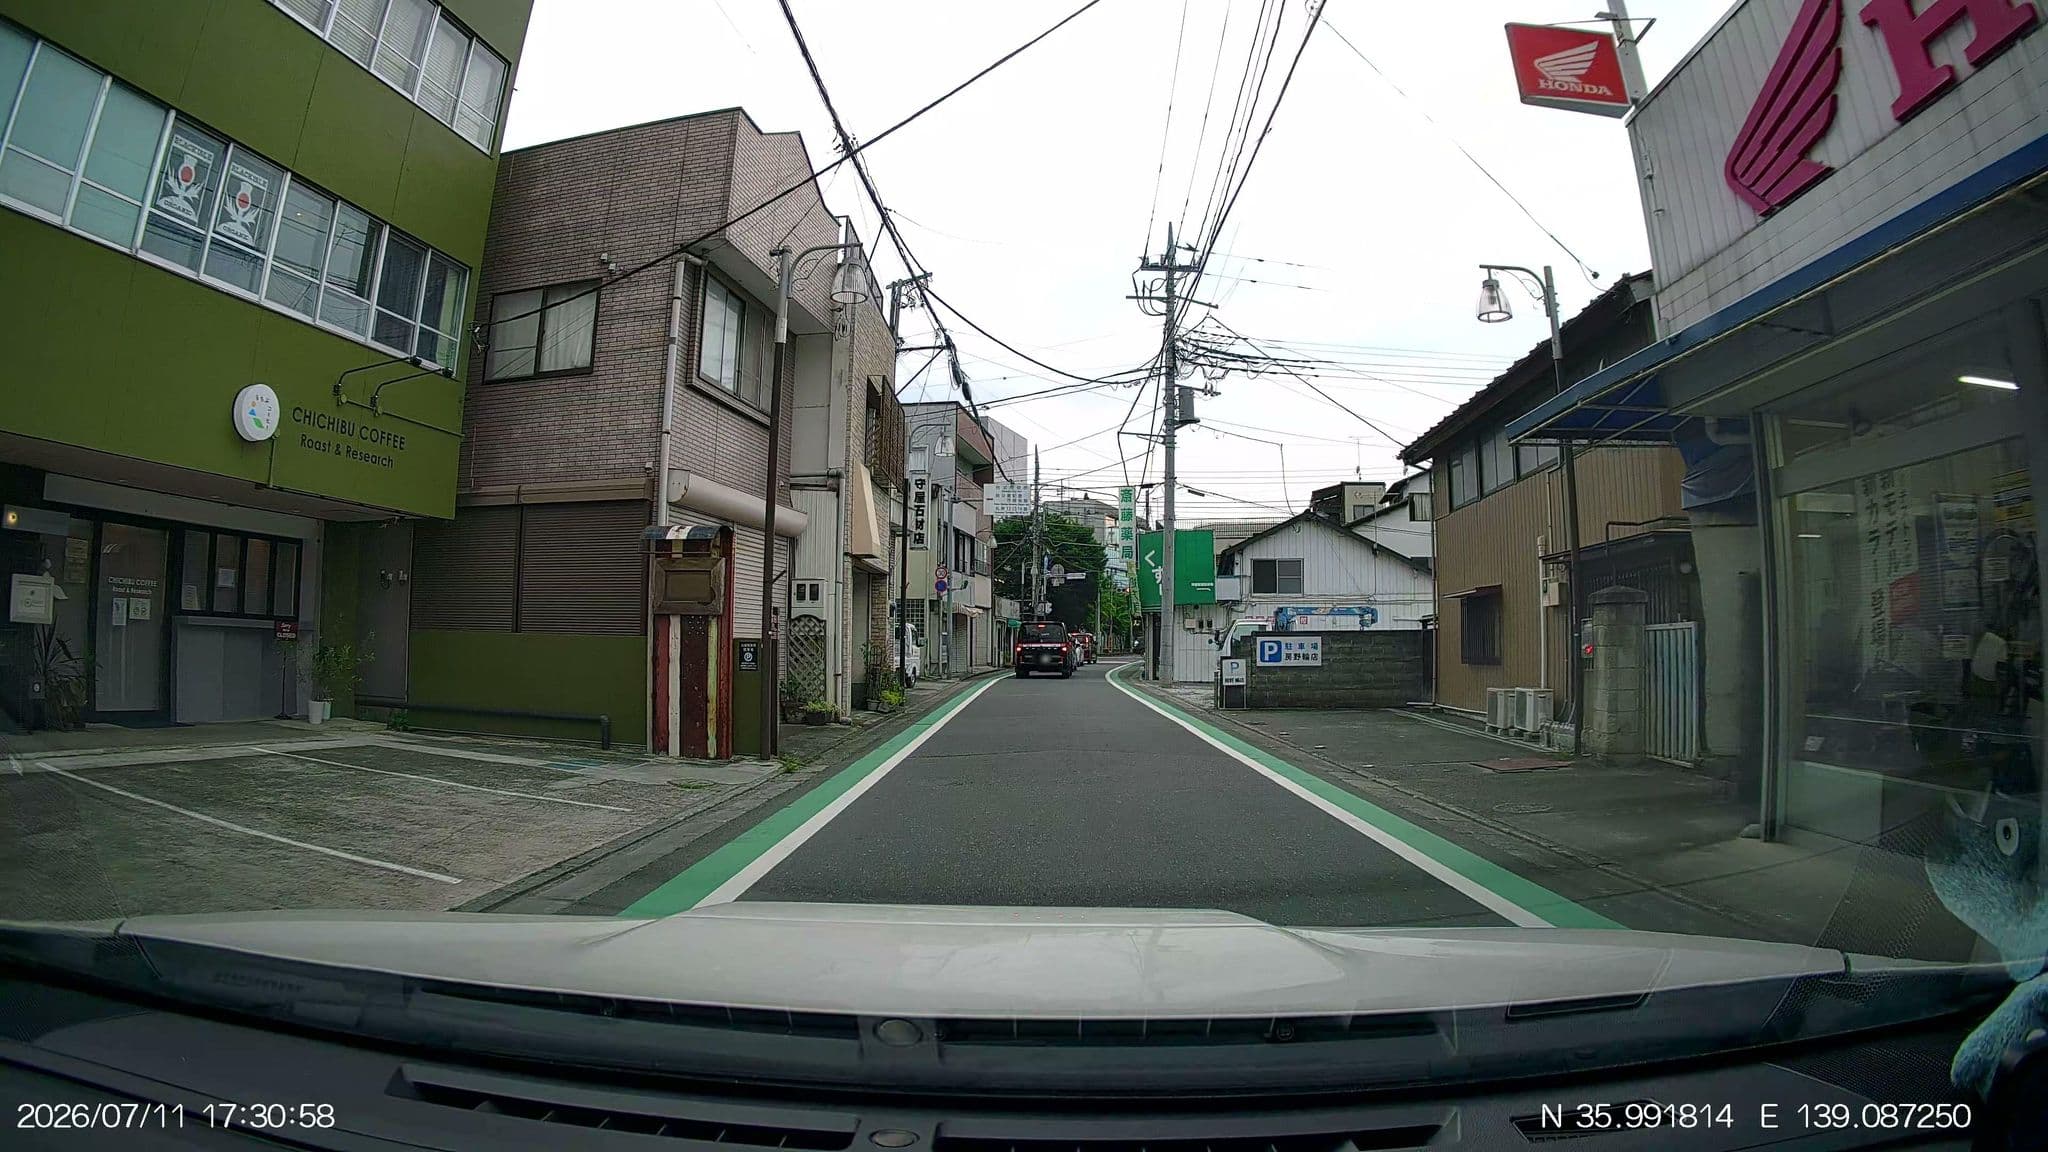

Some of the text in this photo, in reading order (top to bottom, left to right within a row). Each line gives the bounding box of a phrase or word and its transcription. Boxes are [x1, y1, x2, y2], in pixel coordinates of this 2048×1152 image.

[1538, 79, 1614, 96] HONDA
[292, 407, 406, 450] CHICHIBU COFFEE
[301, 433, 394, 468] Roast & Research
[914, 479, 926, 545] 守屋石材店
[1264, 642, 1279, 661] P
[1285, 642, 1319, 650] 駐車場
[1230, 662, 1240, 673] P
